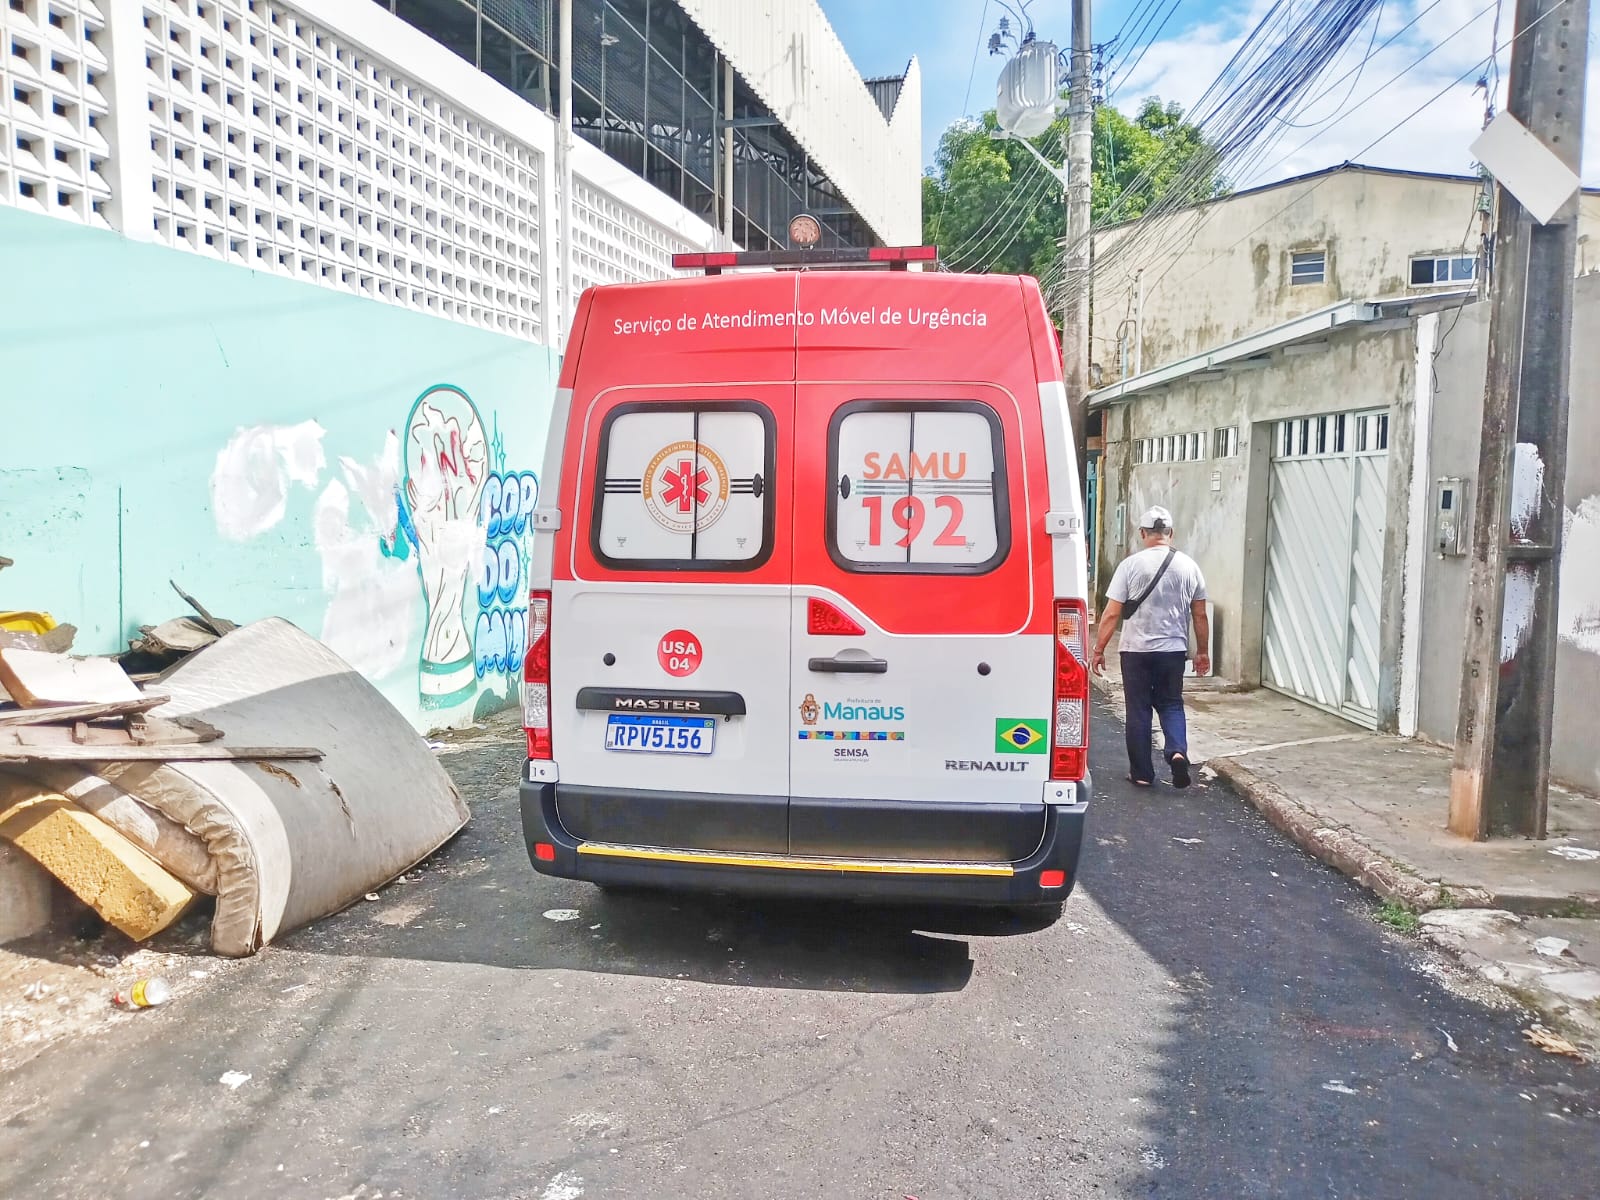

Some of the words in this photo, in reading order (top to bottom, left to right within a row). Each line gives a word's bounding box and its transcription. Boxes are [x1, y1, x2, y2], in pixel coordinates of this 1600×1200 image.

[614, 316, 672, 336] Serviço
[676, 313, 697, 331] de
[702, 309, 814, 329] Atendimento
[820, 306, 875, 326] Móvel
[879, 306, 902, 325] de
[908, 307, 987, 329] Urgência
[863, 452, 966, 480] SAMU
[862, 495, 966, 548] 192
[662, 641, 697, 655] USA
[669, 656, 690, 670] 04
[615, 698, 701, 711] MASTER
[823, 702, 905, 720] Manaus
[614, 726, 702, 749] RPV5I56
[834, 748, 869, 757] SEMSA
[945, 759, 1030, 772] RENAULT
